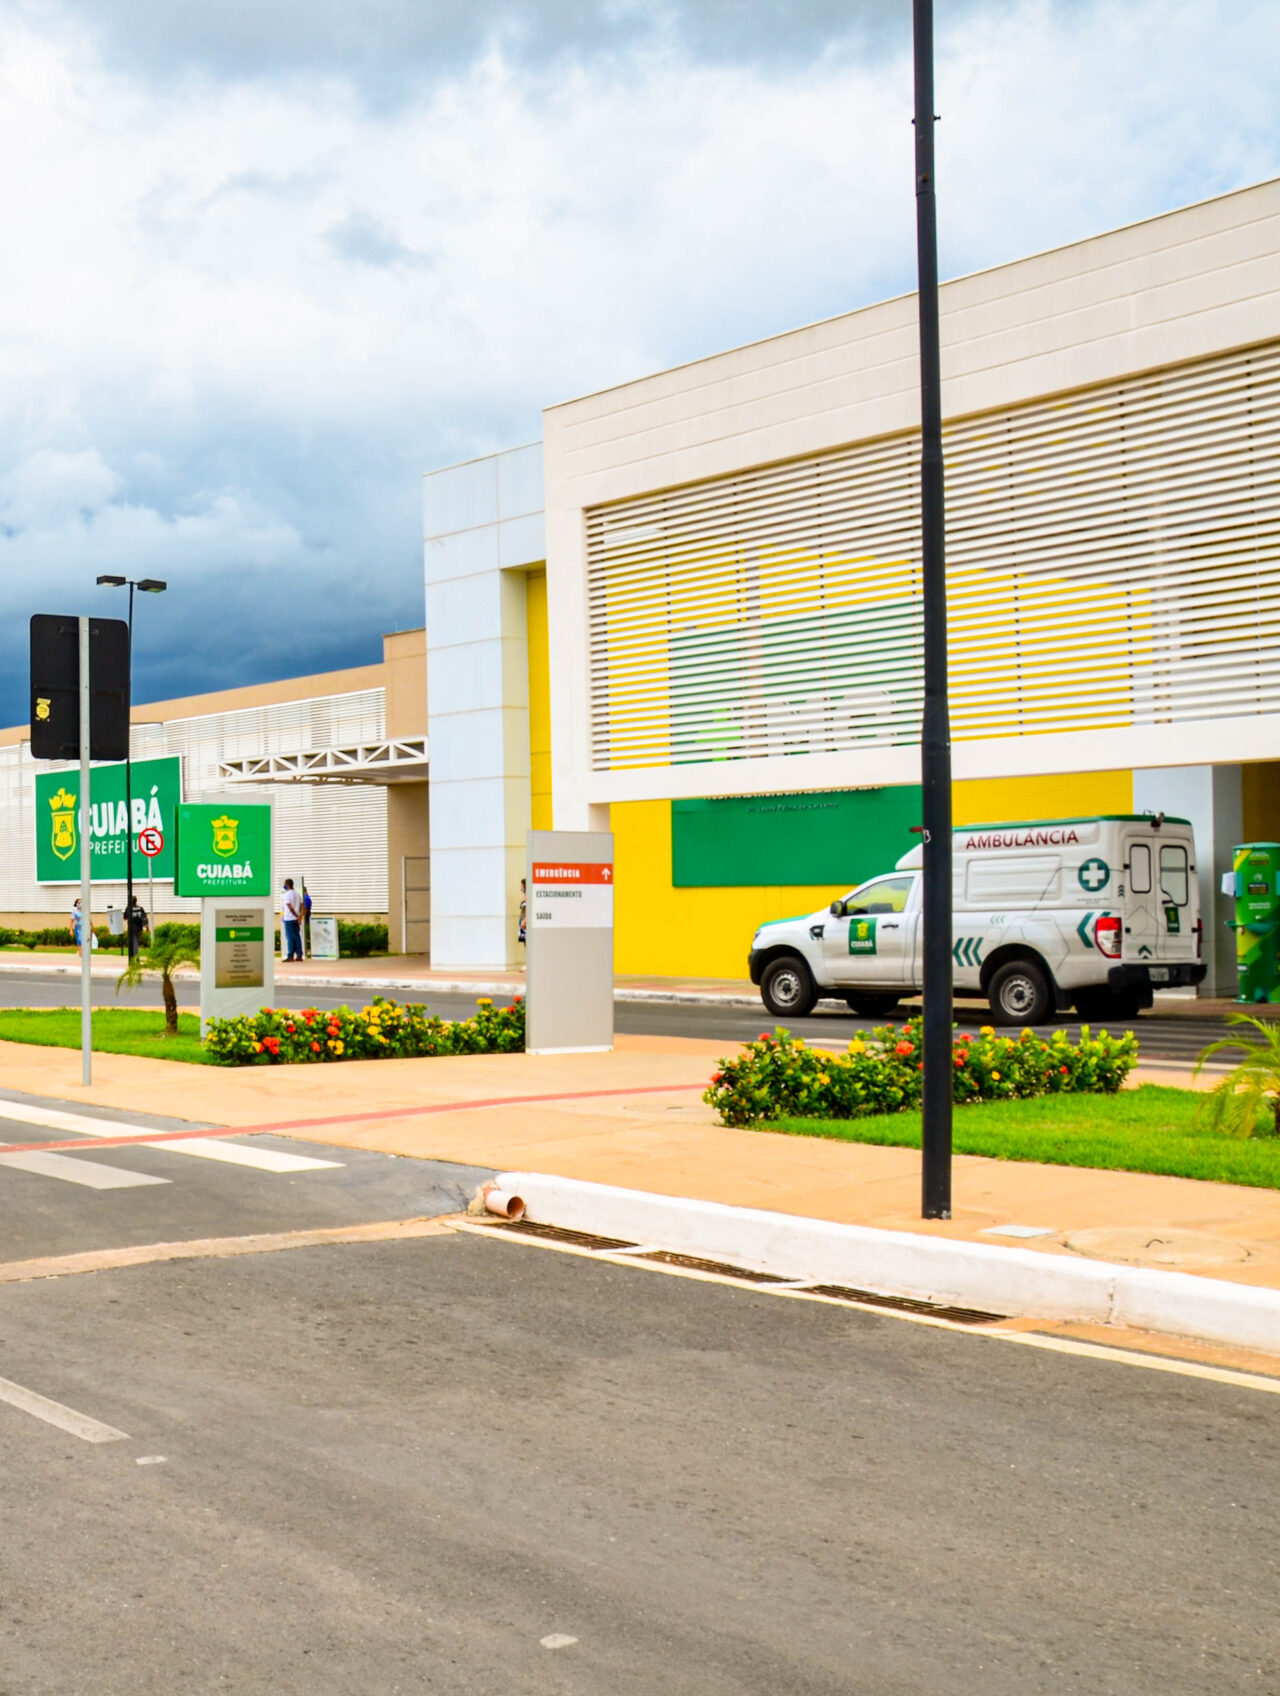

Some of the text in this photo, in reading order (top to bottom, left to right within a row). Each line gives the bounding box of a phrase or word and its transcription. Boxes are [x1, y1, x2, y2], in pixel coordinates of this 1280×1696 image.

[966, 828, 1078, 849] AMBULÂNCIA
[197, 860, 253, 879] CUIABÁ
[535, 868, 581, 878] EMERGÊNCIA
[536, 890, 582, 898] ESTACIONAMENTO
[536, 912, 552, 920] SAÍDA
